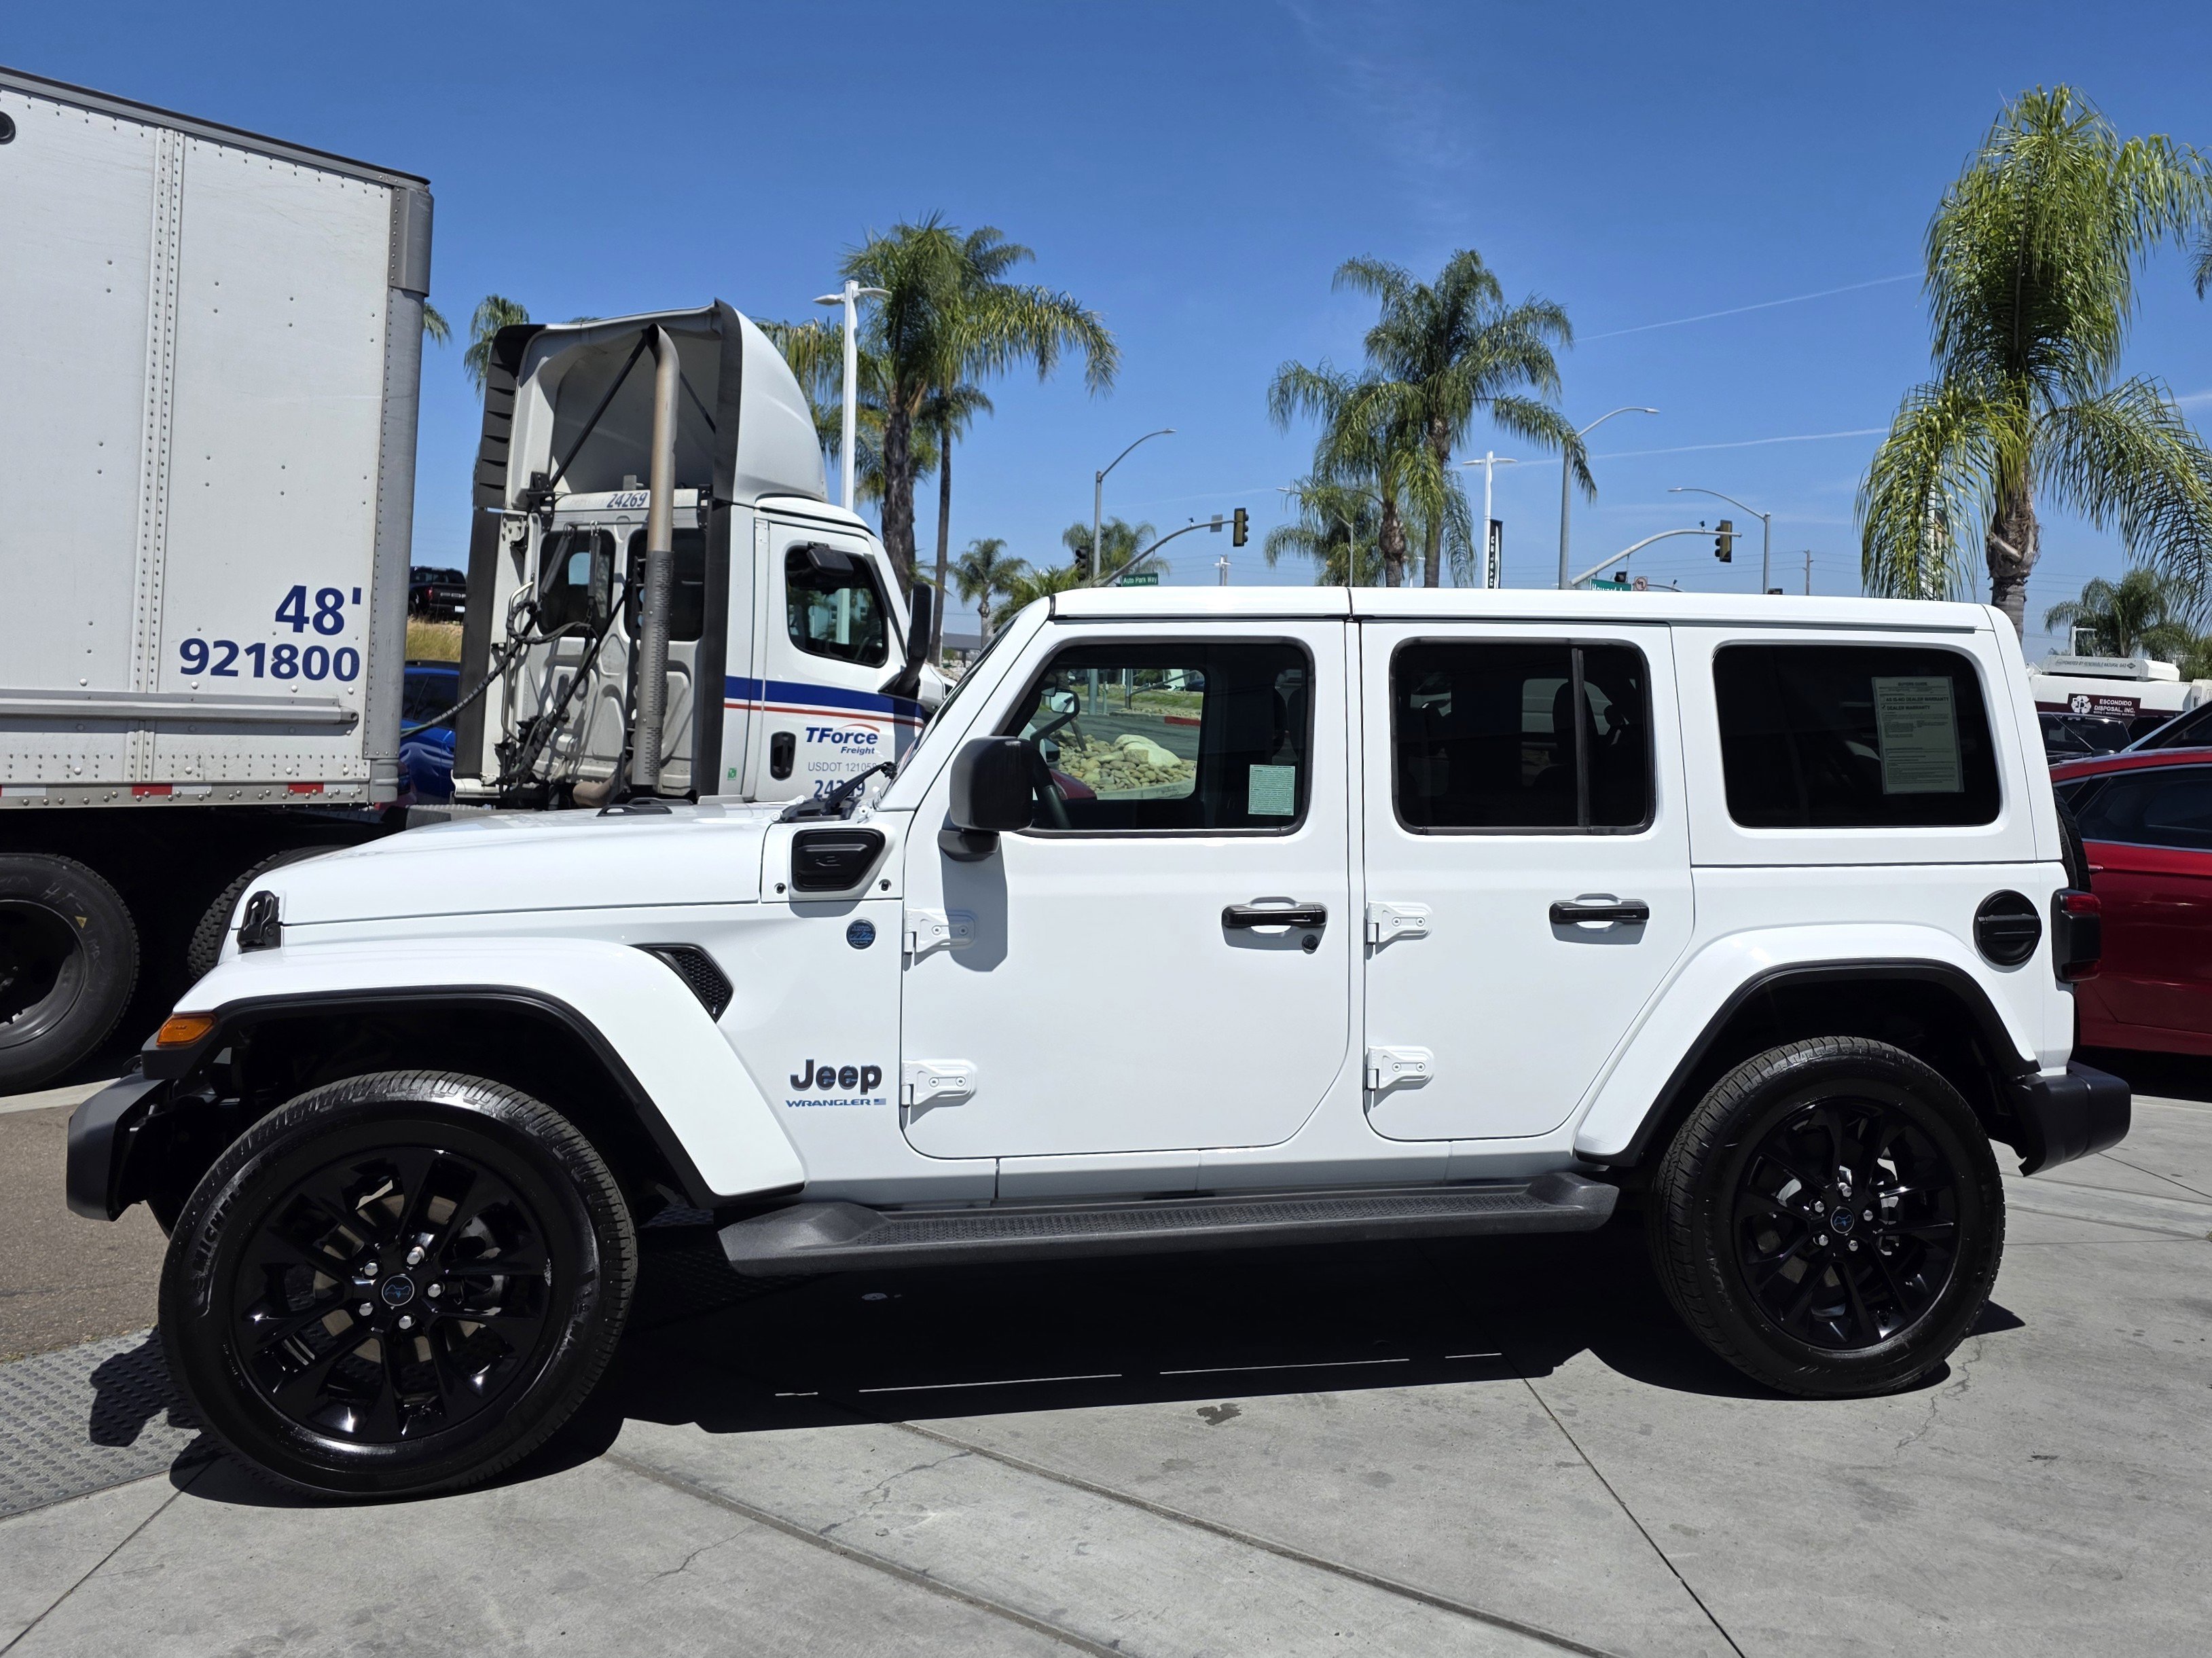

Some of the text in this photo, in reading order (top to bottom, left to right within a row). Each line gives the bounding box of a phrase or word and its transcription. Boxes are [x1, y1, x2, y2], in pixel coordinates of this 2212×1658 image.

[606, 492, 648, 508] 24269
[274, 585, 362, 636] 48'
[179, 638, 361, 682] 921800
[2094, 705, 2123, 713] DISPOSAL,
[805, 726, 878, 745] TForce
[840, 746, 875, 756] Freight
[808, 761, 842, 772] USDOT
[814, 779, 865, 798] 249
[790, 1058, 882, 1095] Jeep
[785, 1099, 871, 1108] WRANGLER
